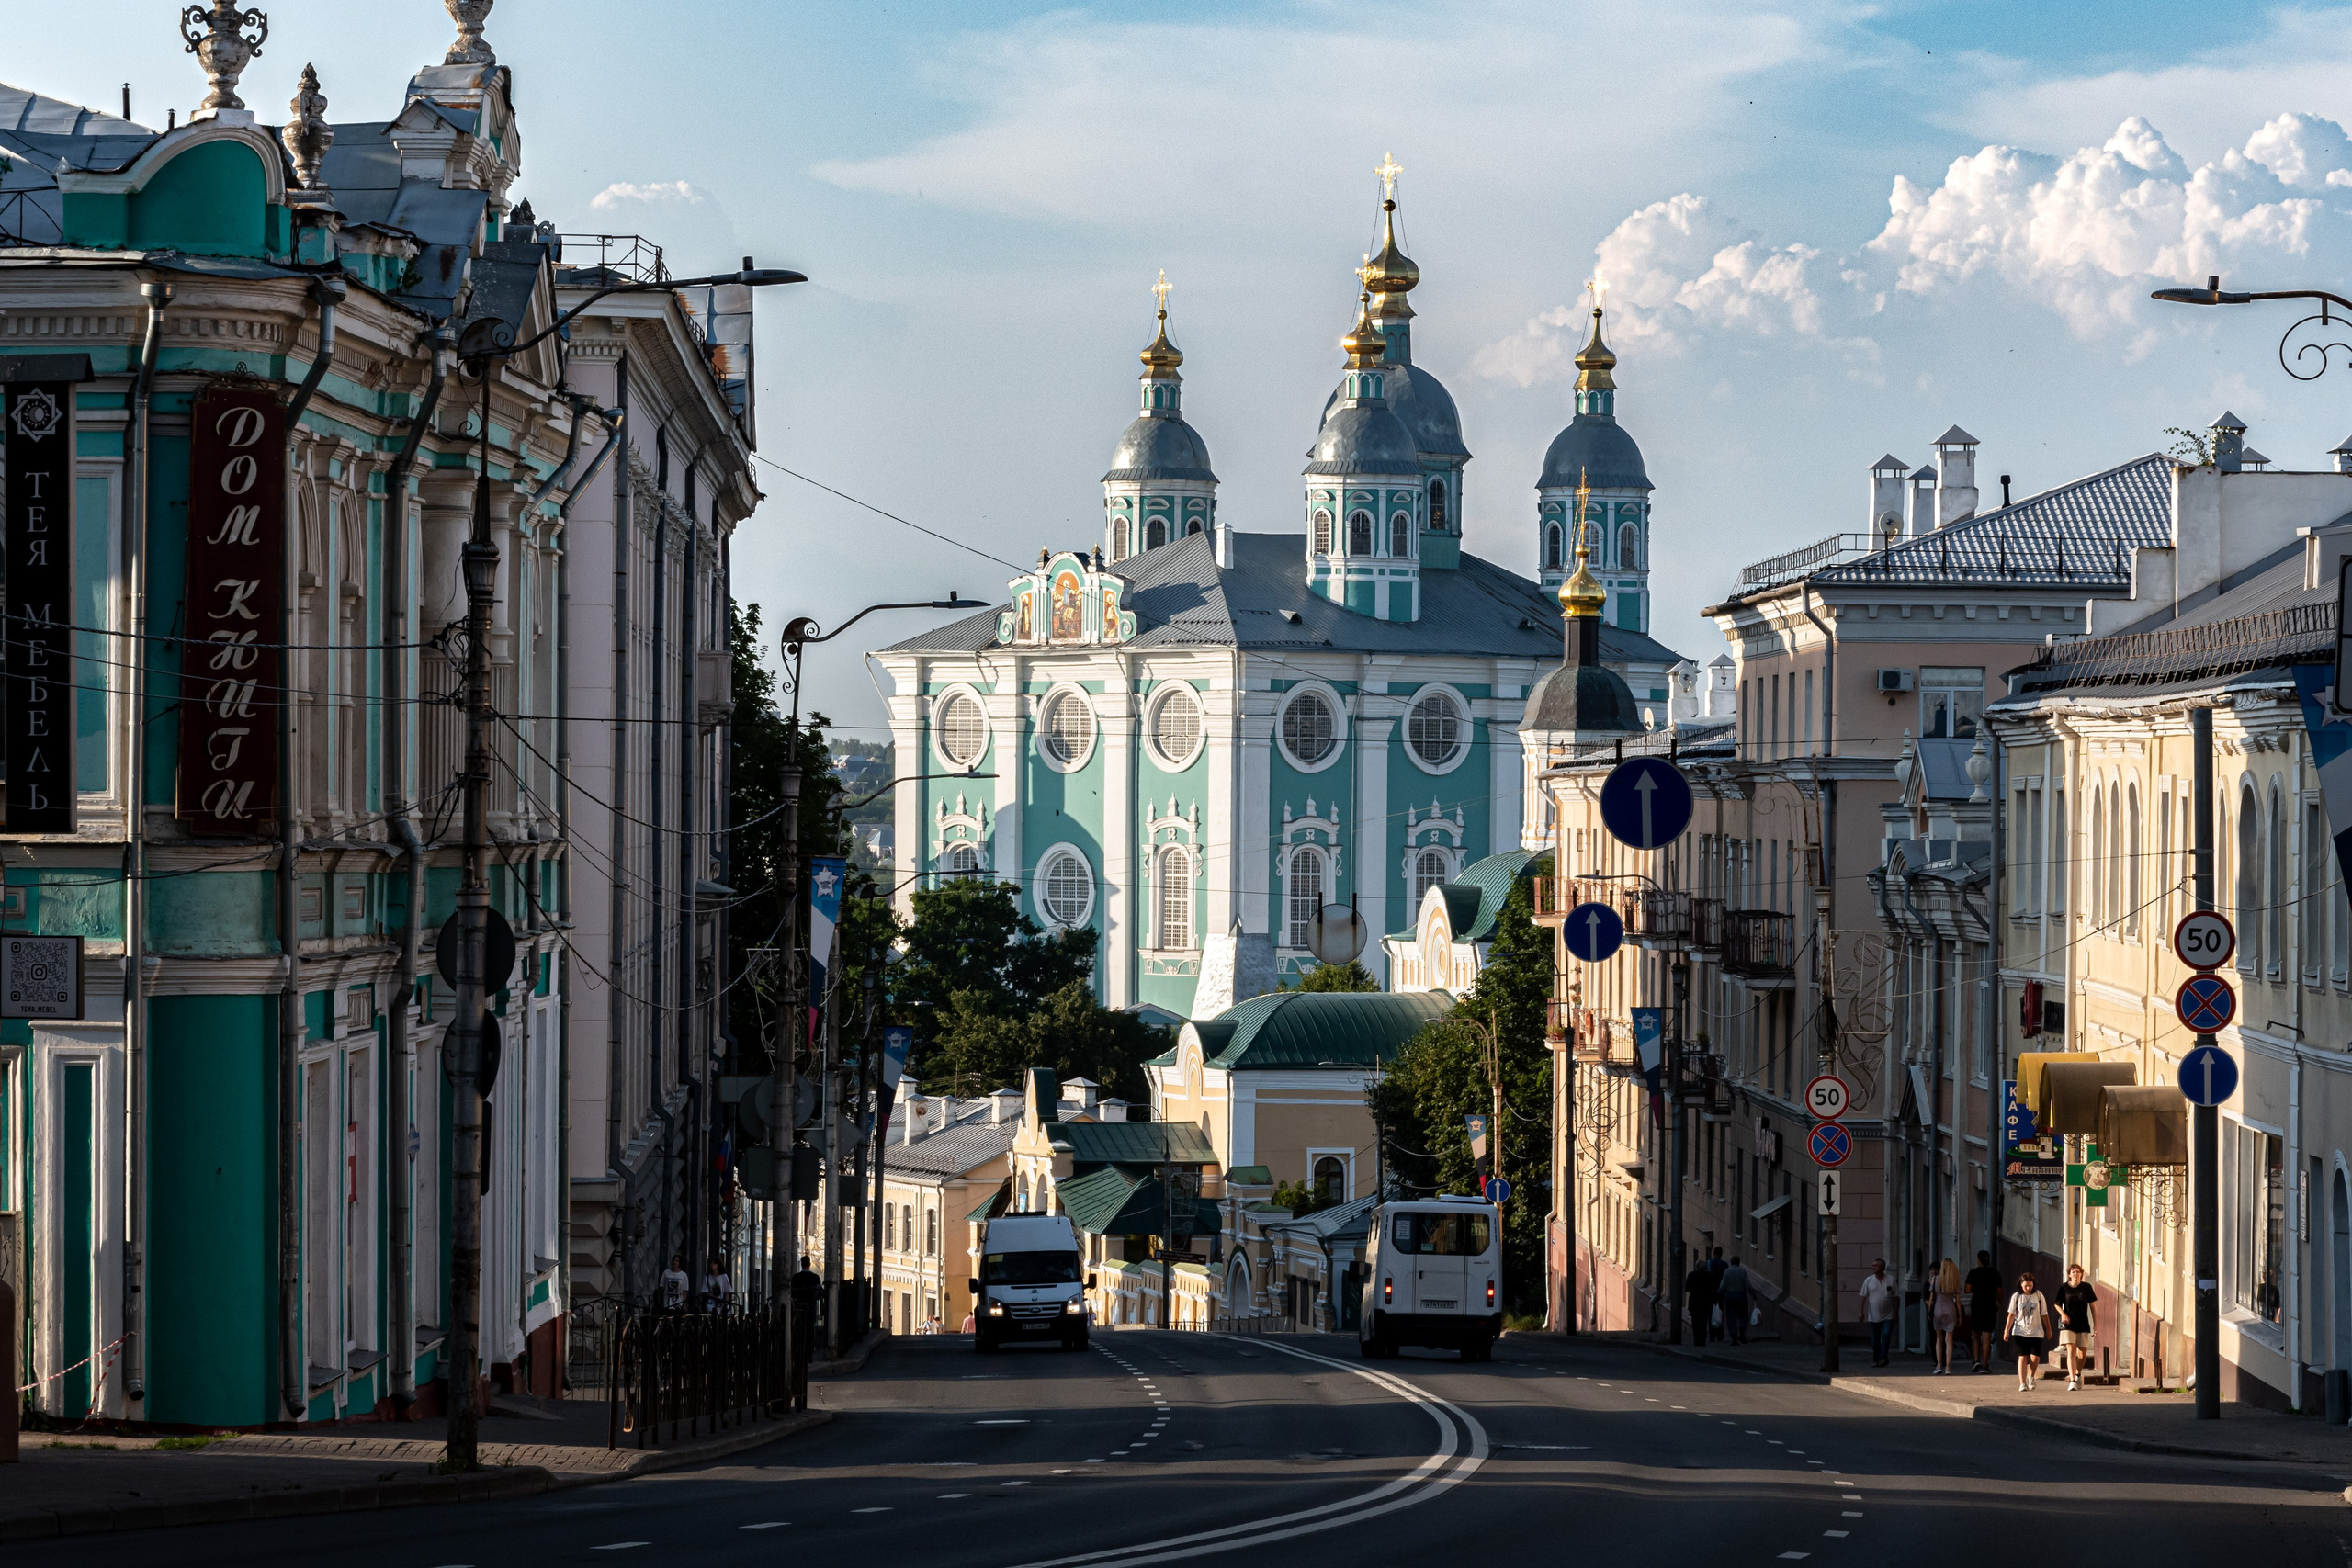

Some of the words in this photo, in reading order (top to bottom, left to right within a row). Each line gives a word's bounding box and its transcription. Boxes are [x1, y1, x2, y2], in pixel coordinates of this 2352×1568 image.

[207, 407, 265, 546] ДОМ
[25, 471, 51, 567] ТЕЯ
[23, 603, 52, 811] МЕБЕЛЬ
[201, 579, 260, 819] КНИГИ
[2188, 928, 2222, 953] 50
[1815, 1088, 1840, 1106] 50
[2007, 1087, 2018, 1140] КАФЕ
[2007, 1161, 2064, 1176] Мельниц
